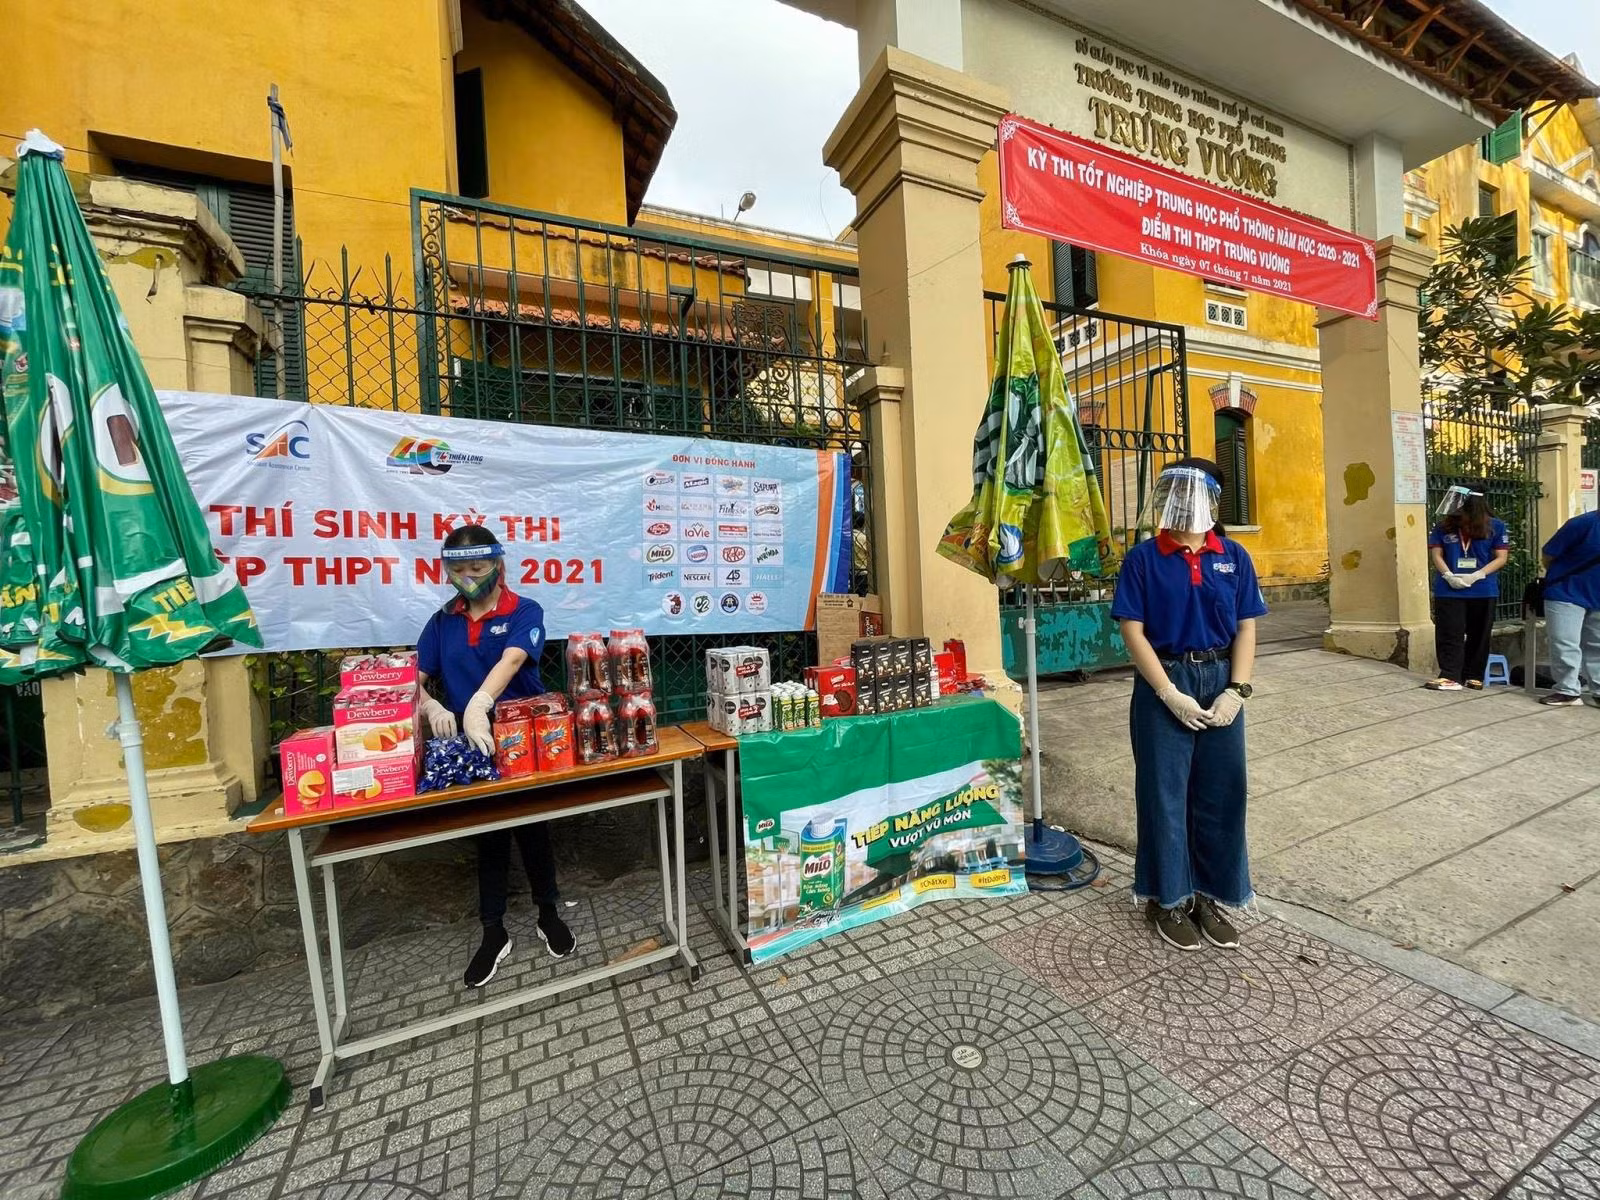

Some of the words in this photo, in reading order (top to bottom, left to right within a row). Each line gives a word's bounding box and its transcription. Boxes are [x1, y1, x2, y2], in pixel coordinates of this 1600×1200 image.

[1136, 88, 1183, 123] TRUNG
[1187, 108, 1215, 136] HỌC
[1088, 95, 1190, 168] TRƯNG
[1196, 136, 1278, 198] VƯƠNG
[1027, 145, 1048, 172] KỲ
[1051, 156, 1074, 180] THI
[1078, 160, 1104, 189] TỐT
[1106, 172, 1153, 207] NGHIỆP
[1155, 189, 1193, 219] TRUNG
[1196, 201, 1217, 228] HỌC
[1219, 207, 1240, 232] PHỔ
[1242, 217, 1275, 243] THÔNG
[1276, 227, 1296, 250] NĂM
[1297, 235, 1316, 257] HỌC
[1317, 242, 1337, 261] 2020
[1342, 250, 1360, 269] 2021
[1141, 213, 1171, 242] ĐIỂM
[1173, 225, 1192, 247] THI
[1194, 232, 1222, 255] THPT
[1224, 240, 1257, 265] TRƯNG
[1259, 251, 1290, 275] VƯƠNG
[1140, 242, 1169, 261] Khóa
[1172, 253, 1197, 270] ngày
[1199, 261, 1211, 272] 07
[1213, 263, 1242, 282] tháng
[1243, 271, 1249, 281] 7
[1251, 274, 1271, 286] năm
[1273, 279, 1292, 292] 2021
[209, 501, 293, 537] THÍ
[313, 510, 417, 540] SINH
[500, 515, 560, 542] THI
[283, 557, 399, 586] THPT
[520, 558, 602, 584] 2021
[648, 571, 673, 582] Trident
[726, 569, 741, 582] 45
[353, 671, 402, 682] Dewberry
[346, 707, 399, 720] Dewberry
[287, 751, 295, 787] Dewberry
[758, 821, 773, 829] MILO
[852, 819, 889, 848] TIẾP
[895, 807, 941, 832] NĂNG
[945, 785, 1000, 812] LƯỢNG
[890, 828, 926, 848] VƯỢT
[943, 810, 971, 825] MÔN
[804, 859, 831, 874] MILO
